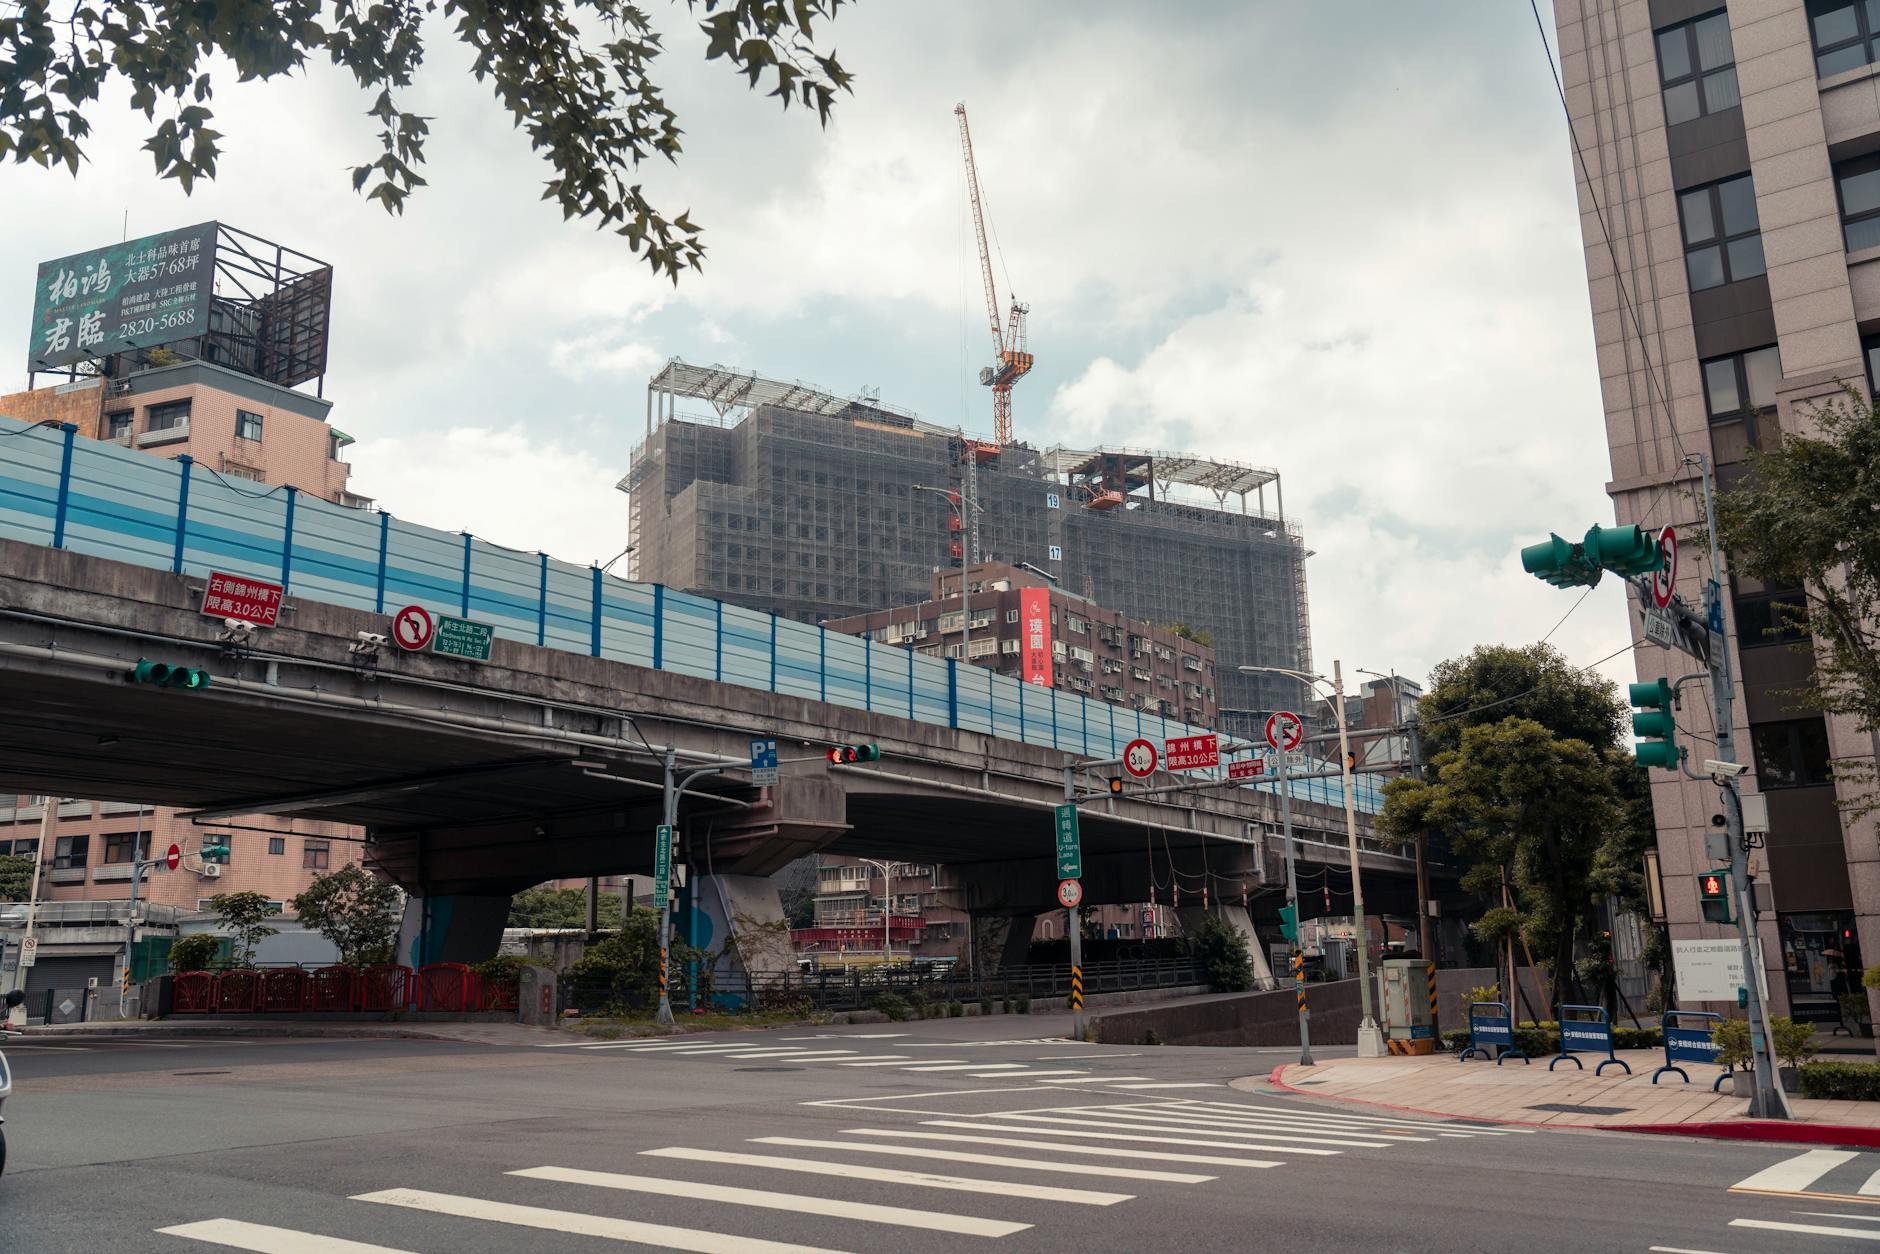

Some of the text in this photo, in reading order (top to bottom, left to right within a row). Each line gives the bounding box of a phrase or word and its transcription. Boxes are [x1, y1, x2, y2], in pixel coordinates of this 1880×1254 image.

[125, 238, 200, 267] 北士科品味首席
[119, 308, 195, 338] 2820-5688
[44, 310, 106, 356] 君臨
[1048, 495, 1058, 507] 19
[1050, 547, 1060, 559] 17
[210, 578, 281, 604] 右側錦州橋下
[206, 595, 276, 621] 限高3.0公尺
[443, 620, 488, 637] 新生北路二段
[751, 742, 766, 760] P
[1166, 738, 1216, 754] 錦州橋下
[1168, 751, 1218, 767] 限高3.0公尺
[1270, 755, 1303, 765] 公除外
[1058, 844, 1078, 852] U-turn
